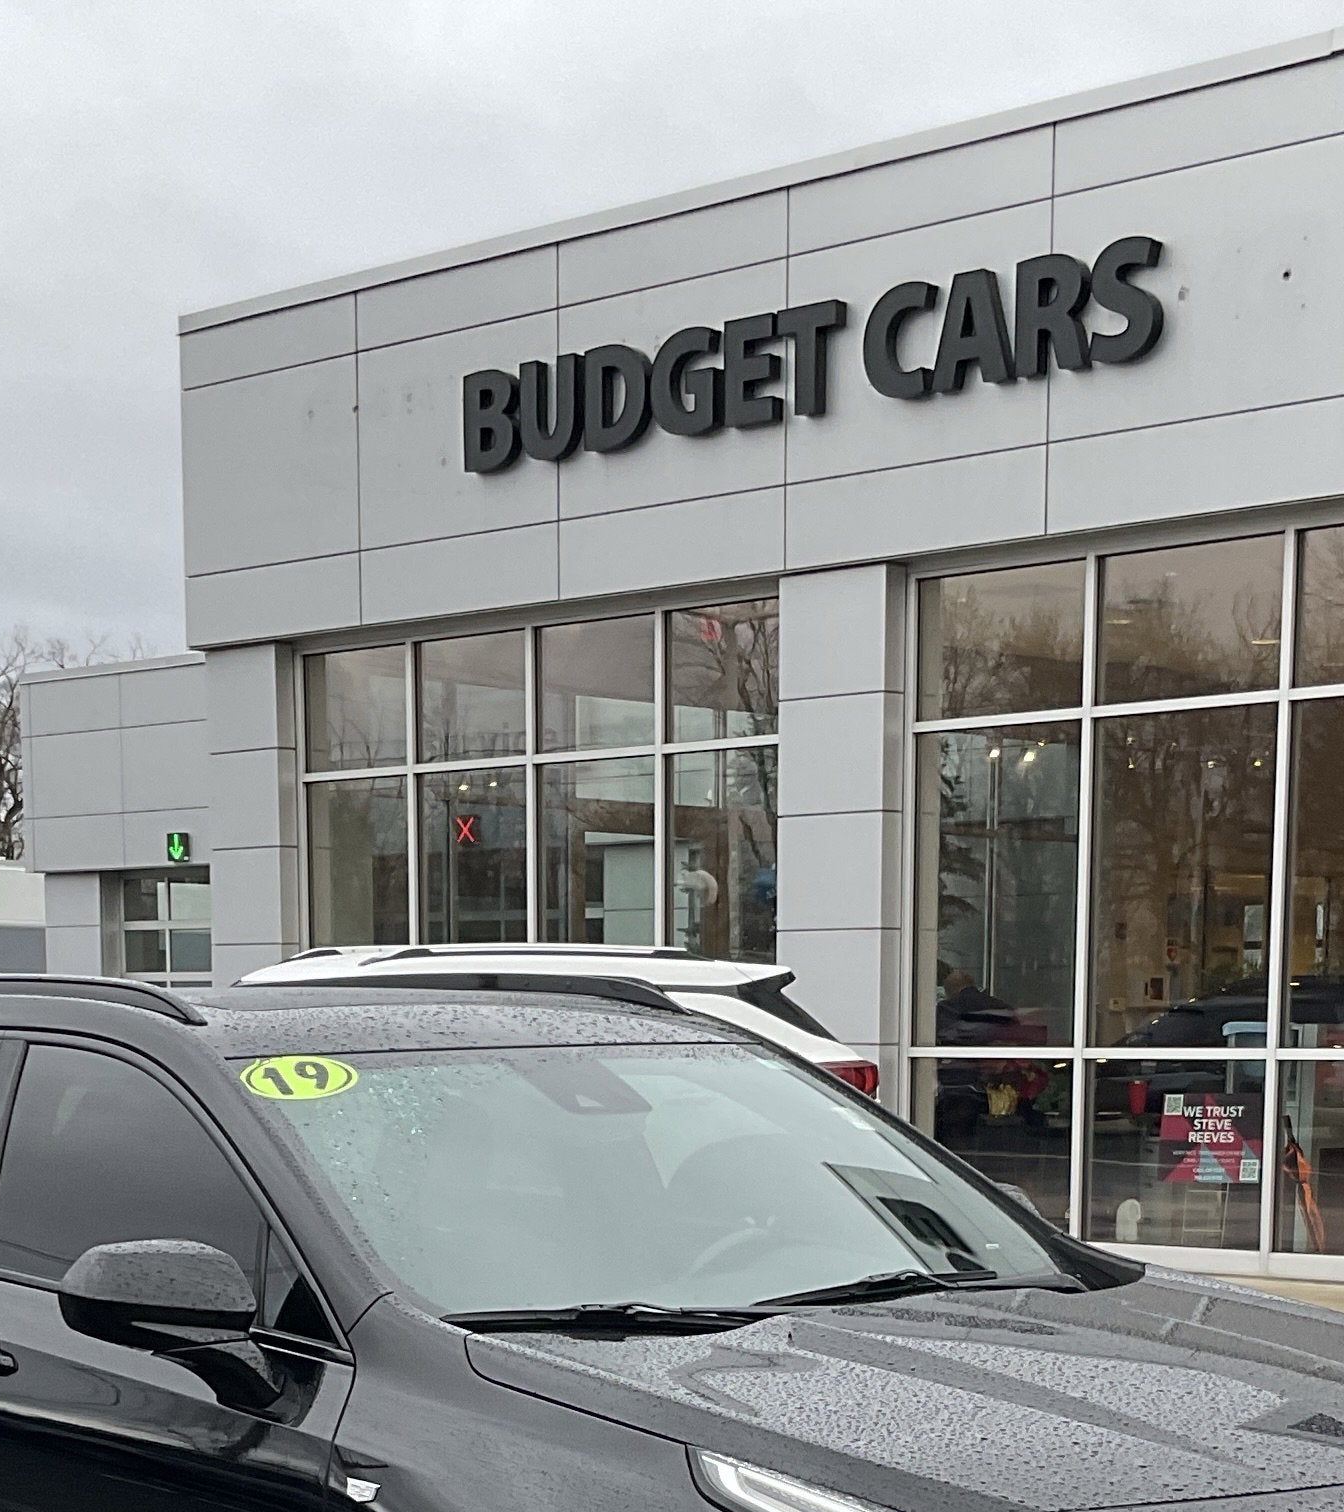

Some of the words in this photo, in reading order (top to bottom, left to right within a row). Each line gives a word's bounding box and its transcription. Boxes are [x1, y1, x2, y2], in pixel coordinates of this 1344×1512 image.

[462, 298, 847, 474] BUDGET
[863, 235, 1164, 400] CARS
[262, 1061, 329, 1095] 19
[1183, 1105, 1204, 1118] WE
[1205, 1105, 1245, 1118] TRUST
[1193, 1118, 1233, 1131] STEVE
[1188, 1131, 1235, 1143] REEVES
